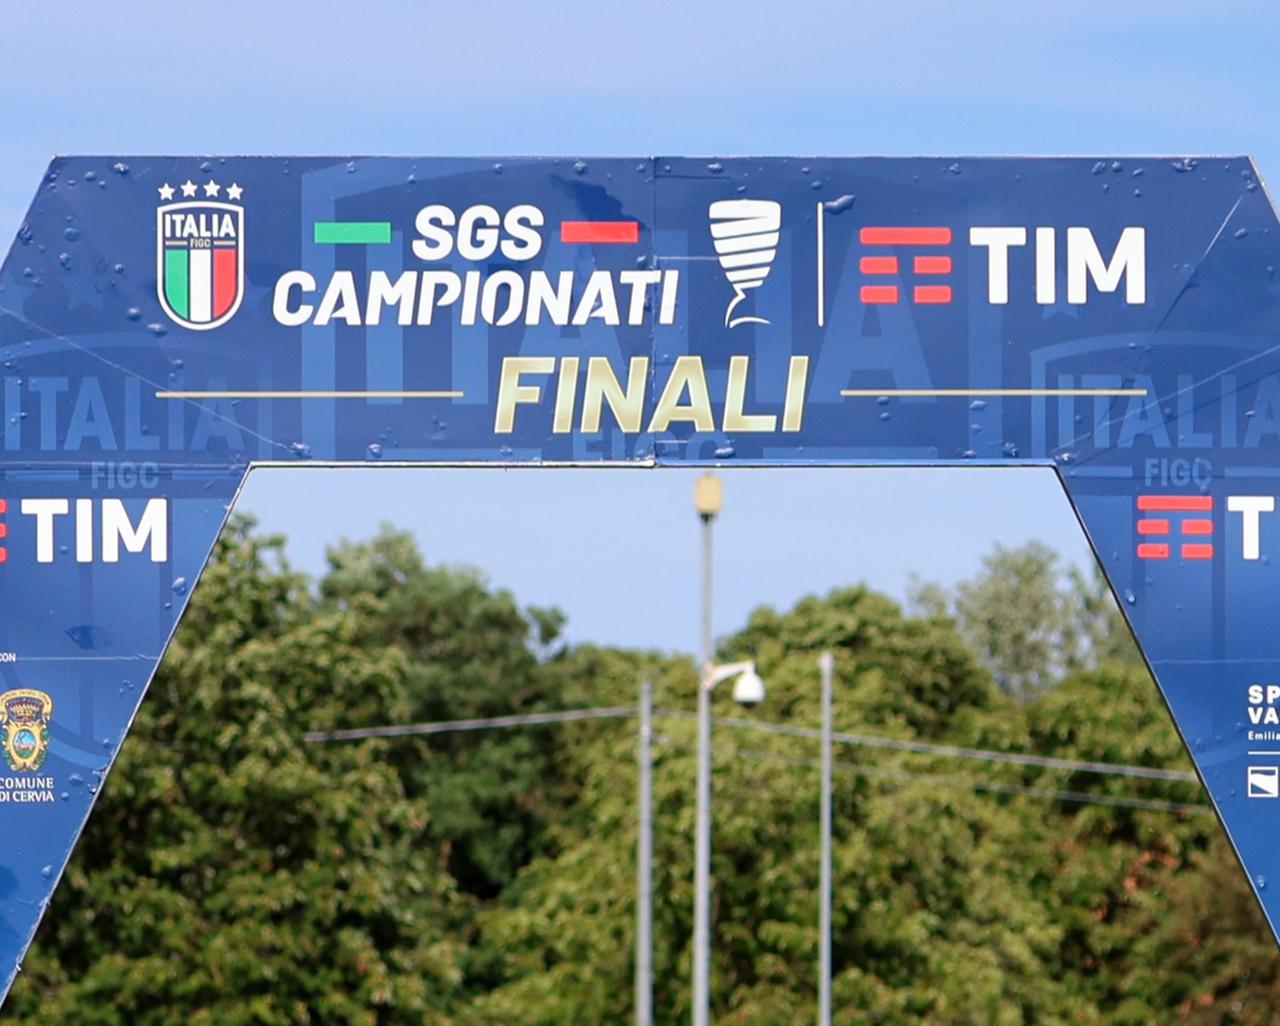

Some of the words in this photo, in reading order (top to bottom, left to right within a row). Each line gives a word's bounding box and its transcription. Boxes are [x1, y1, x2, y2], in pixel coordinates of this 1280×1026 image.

[165, 213, 236, 238] ITALIA
[412, 204, 545, 261] SGS
[969, 226, 1146, 304] TIM
[272, 269, 680, 327] CAMPIONATI
[4, 376, 246, 452] ITALIA
[494, 355, 810, 434] FINALI
[91, 461, 160, 489] FIGC
[21, 498, 168, 563] TIM
[12, 790, 55, 802] CERVIA
